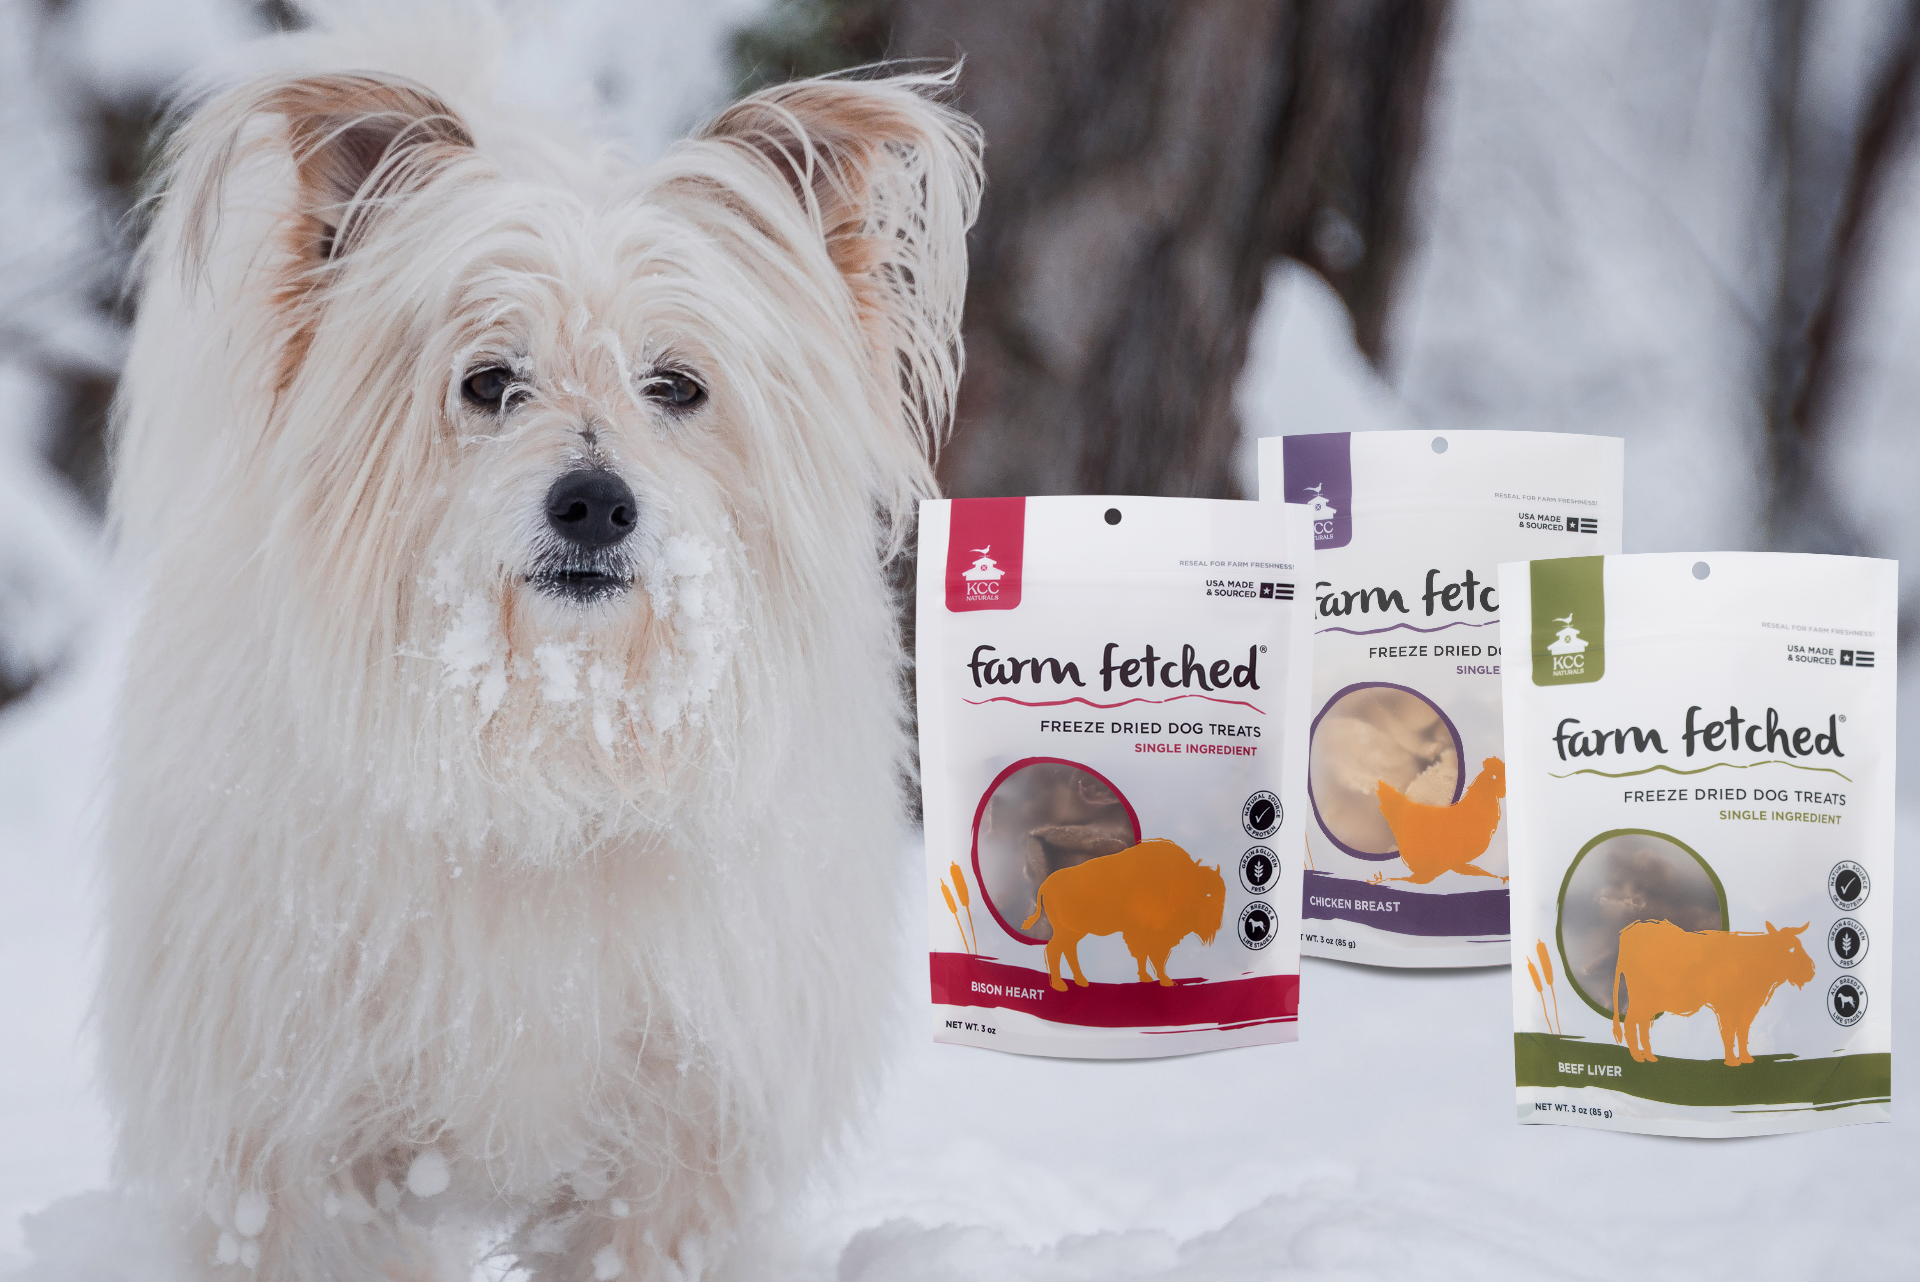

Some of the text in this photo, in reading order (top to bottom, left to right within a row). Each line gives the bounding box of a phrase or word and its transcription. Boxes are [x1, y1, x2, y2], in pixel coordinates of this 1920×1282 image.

[1494, 492, 1520, 500] RESEAL
[1518, 512, 1561, 522] USA MADE
[1314, 521, 1333, 534] CC
[1526, 521, 1564, 531] SOURCED
[1251, 562, 1294, 570] FRESHNESS!
[966, 582, 999, 595] KCC
[1228, 580, 1254, 588] MADE
[1214, 589, 1256, 598] SOURCED
[1422, 569, 1499, 616] fetc
[1761, 622, 1790, 630] RESEAL
[1831, 628, 1874, 637] FRESHNESS!
[1369, 646, 1428, 658] FREEZE
[1434, 646, 1482, 656] DRIED
[1787, 645, 1834, 655] USA MADE
[966, 644, 1086, 687] farm
[1553, 654, 1584, 670] KCC
[1795, 655, 1837, 665] SOURCED
[1456, 665, 1500, 674] SINGLE
[1552, 668, 1584, 676] NATURALS
[1040, 720, 1261, 738] FREEZE DRIED DOG TREATS
[1552, 717, 1668, 761] farm
[1134, 743, 1257, 756] SINGLE INGREDIENT
[1624, 789, 1846, 806] FREEZE DRIED DOG TREATS
[1244, 793, 1281, 818] NATURAL SOURCE
[1719, 810, 1842, 825] SINGLE INGREDIENT
[1252, 825, 1276, 837] PROTEIN
[1830, 863, 1867, 889] NATURAL SOURCE
[1309, 896, 1401, 912] CHICKEN BREAST
[1839, 897, 1863, 909] PROTEIN
[1242, 910, 1250, 921] ALL
[1250, 904, 1271, 915] BREEDS
[1243, 934, 1272, 948] LIFE STAGES
[971, 981, 1045, 1000] BISON HEART
[1830, 984, 1839, 996] ALL
[1839, 978, 1860, 990] BREEDS
[1832, 1010, 1862, 1024] LIFE STAGES
[946, 1020, 963, 1030] NET
[964, 1022, 980, 1032] WT.
[981, 1024, 986, 1033] 3
[1558, 1062, 1622, 1077] BEEF LIVER
[1535, 1102, 1553, 1112] NET
[1554, 1104, 1570, 1113] WT.
[1571, 1105, 1576, 1114] 3
[1589, 1107, 1602, 1117] (85
[1603, 1109, 1613, 1119] g)
